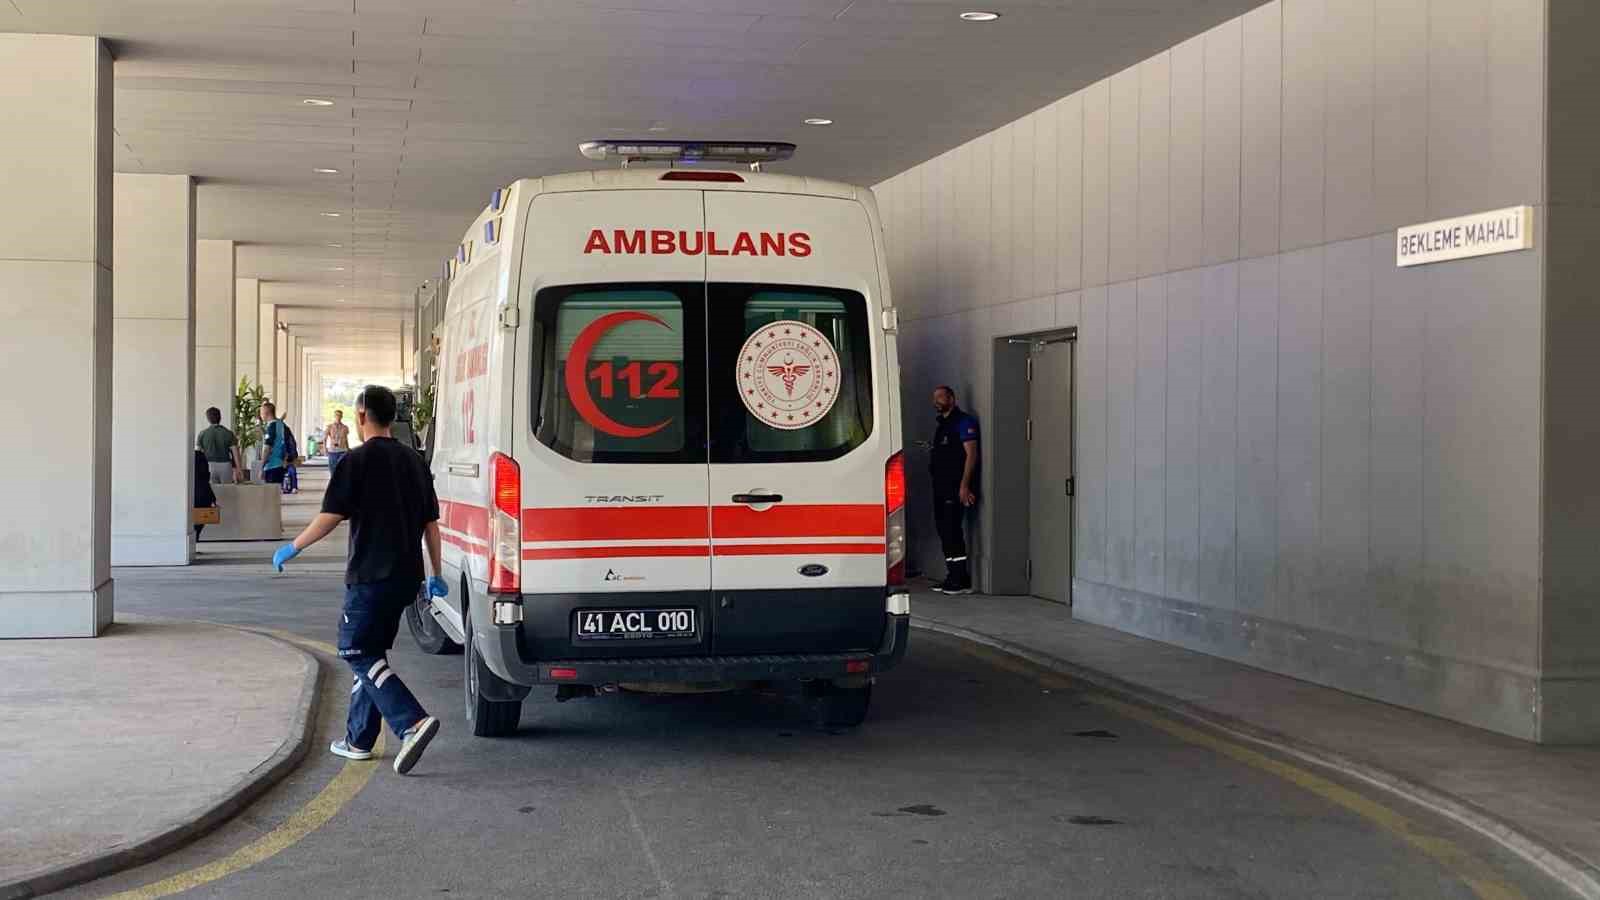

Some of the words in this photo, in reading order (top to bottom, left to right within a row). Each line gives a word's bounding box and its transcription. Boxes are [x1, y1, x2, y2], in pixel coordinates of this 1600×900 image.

[584, 229, 812, 258] AMBULANS
[1401, 226, 1461, 256] BEKLEME
[1465, 211, 1519, 246] MAHALİ
[589, 362, 681, 399] 112
[584, 495, 664, 504] TRANSIT
[584, 613, 603, 633] 41
[610, 612, 652, 633] ACL
[658, 611, 689, 631] 010
